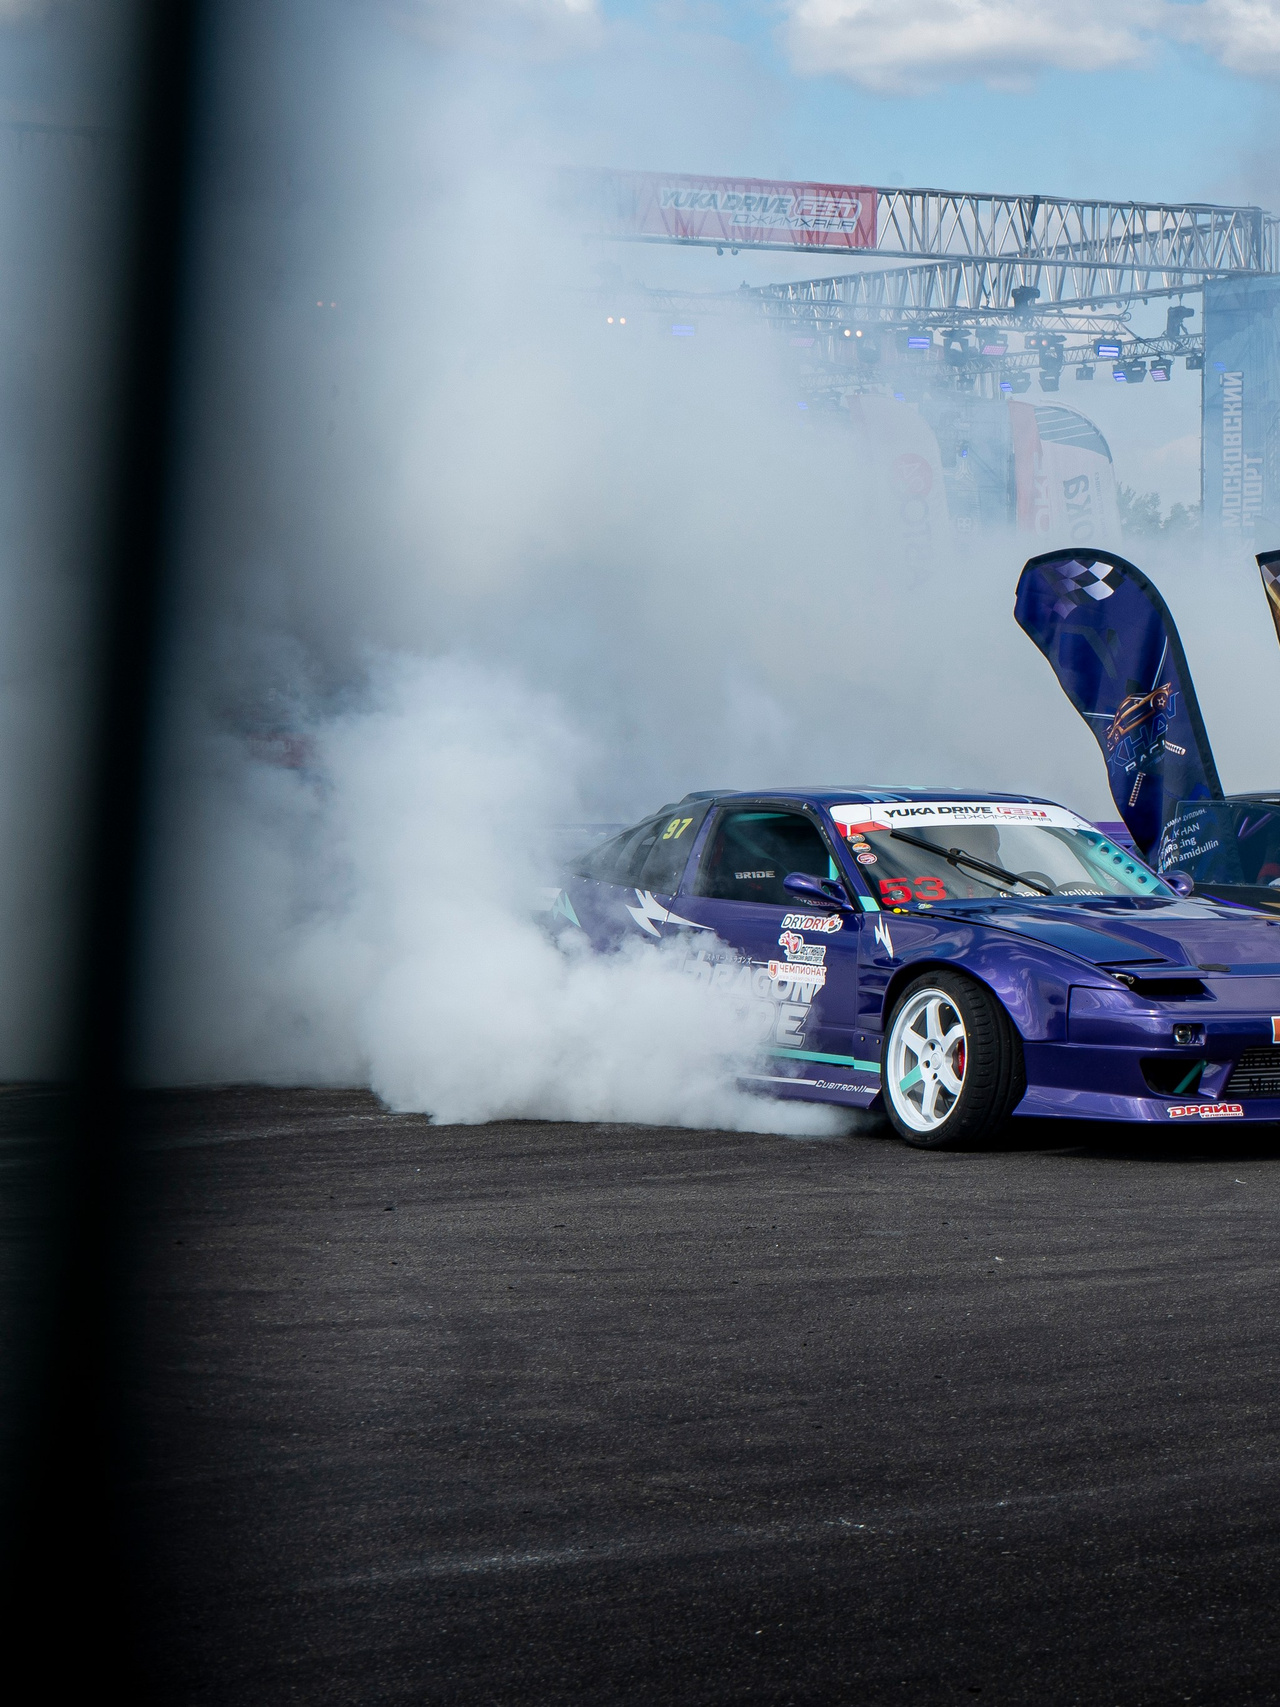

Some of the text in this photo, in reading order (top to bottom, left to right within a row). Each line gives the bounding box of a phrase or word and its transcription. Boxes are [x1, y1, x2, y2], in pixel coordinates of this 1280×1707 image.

[661, 188, 720, 210] YUKA
[721, 193, 792, 213] DRIVE
[732, 213, 857, 231] ДЖИМХАНА
[1219, 371, 1243, 528] МОСКОВСКИЙ
[884, 806, 1048, 818] YUKA DRIVE FEST
[663, 818, 693, 840] 97
[734, 871, 775, 879] BRIDE
[878, 876, 947, 905] 53
[782, 915, 828, 930] DRYDRY
[780, 964, 825, 976] ЧЕМПИОНАТ
[1170, 1103, 1241, 1117] ДРАЙВ
